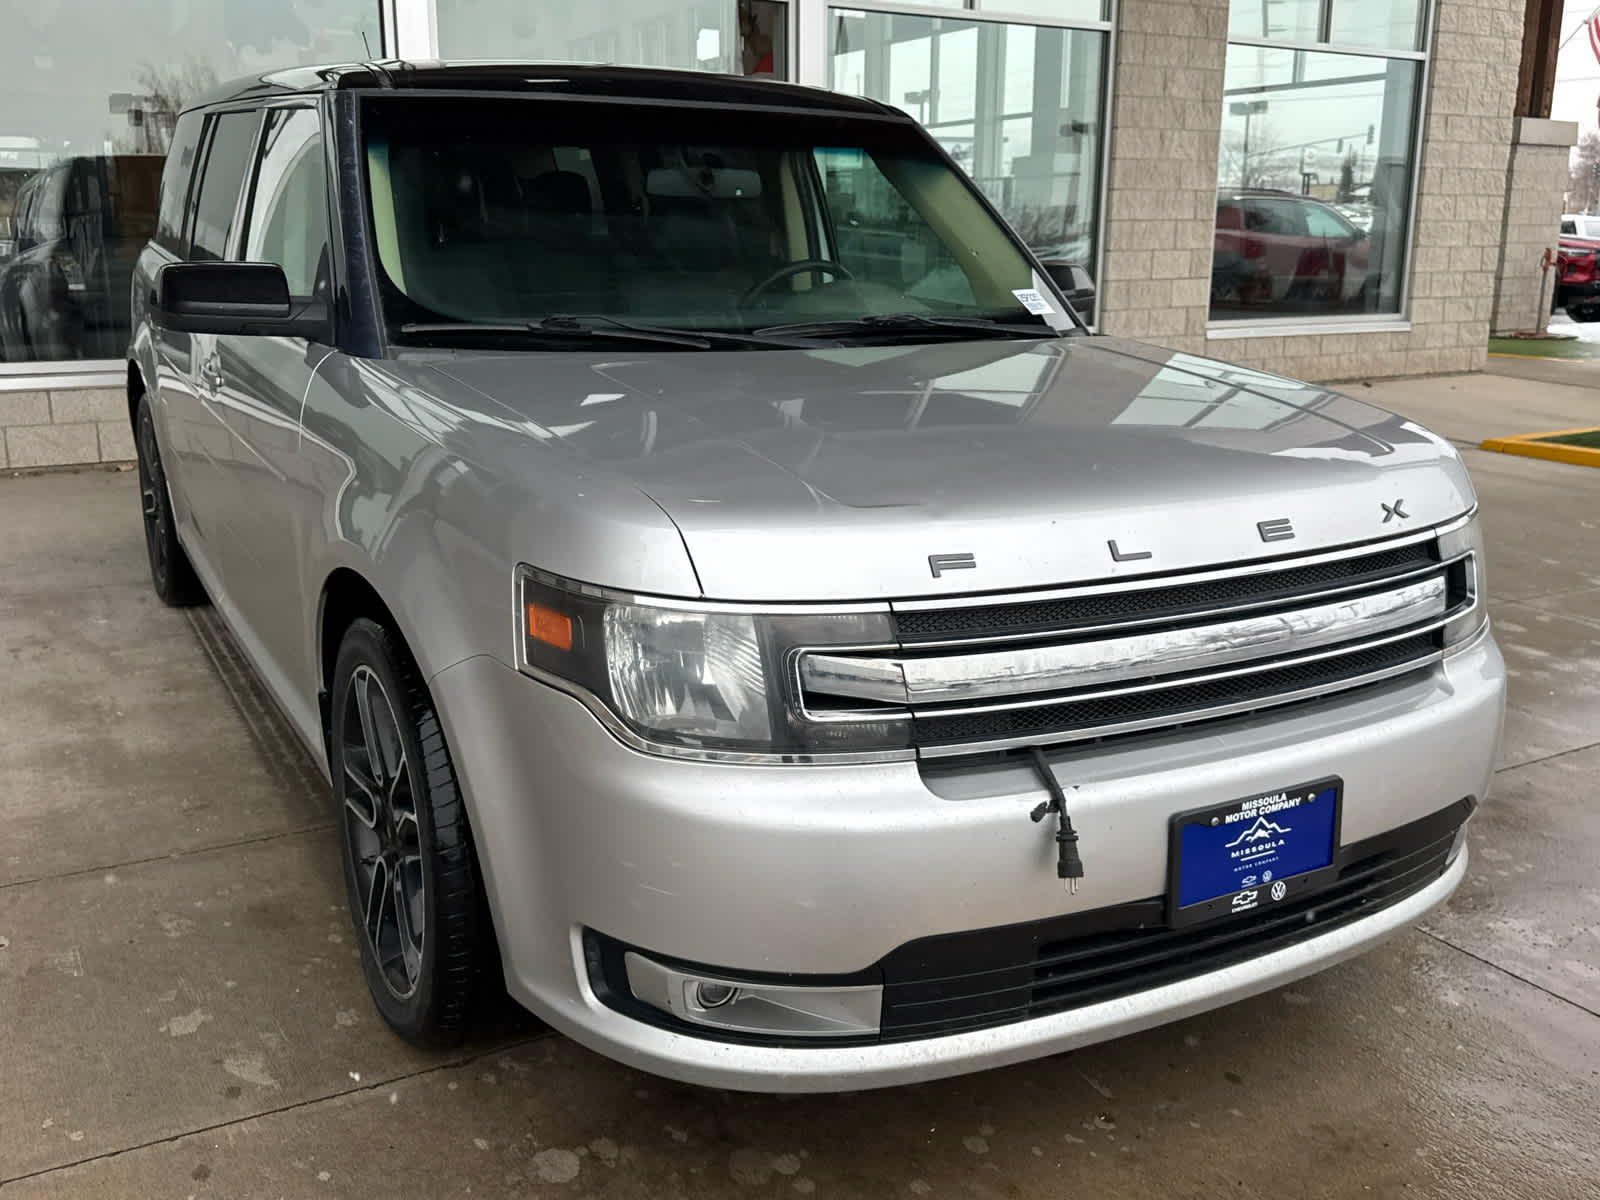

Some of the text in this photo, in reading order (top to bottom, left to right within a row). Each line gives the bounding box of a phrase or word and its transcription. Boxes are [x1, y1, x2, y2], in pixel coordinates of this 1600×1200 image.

[928, 498, 1410, 578] FLEX
[1225, 797, 1302, 824] MOTOR COMPANY
[1241, 792, 1287, 811] MISSOULA
[1231, 839, 1285, 858] MISSOULA
